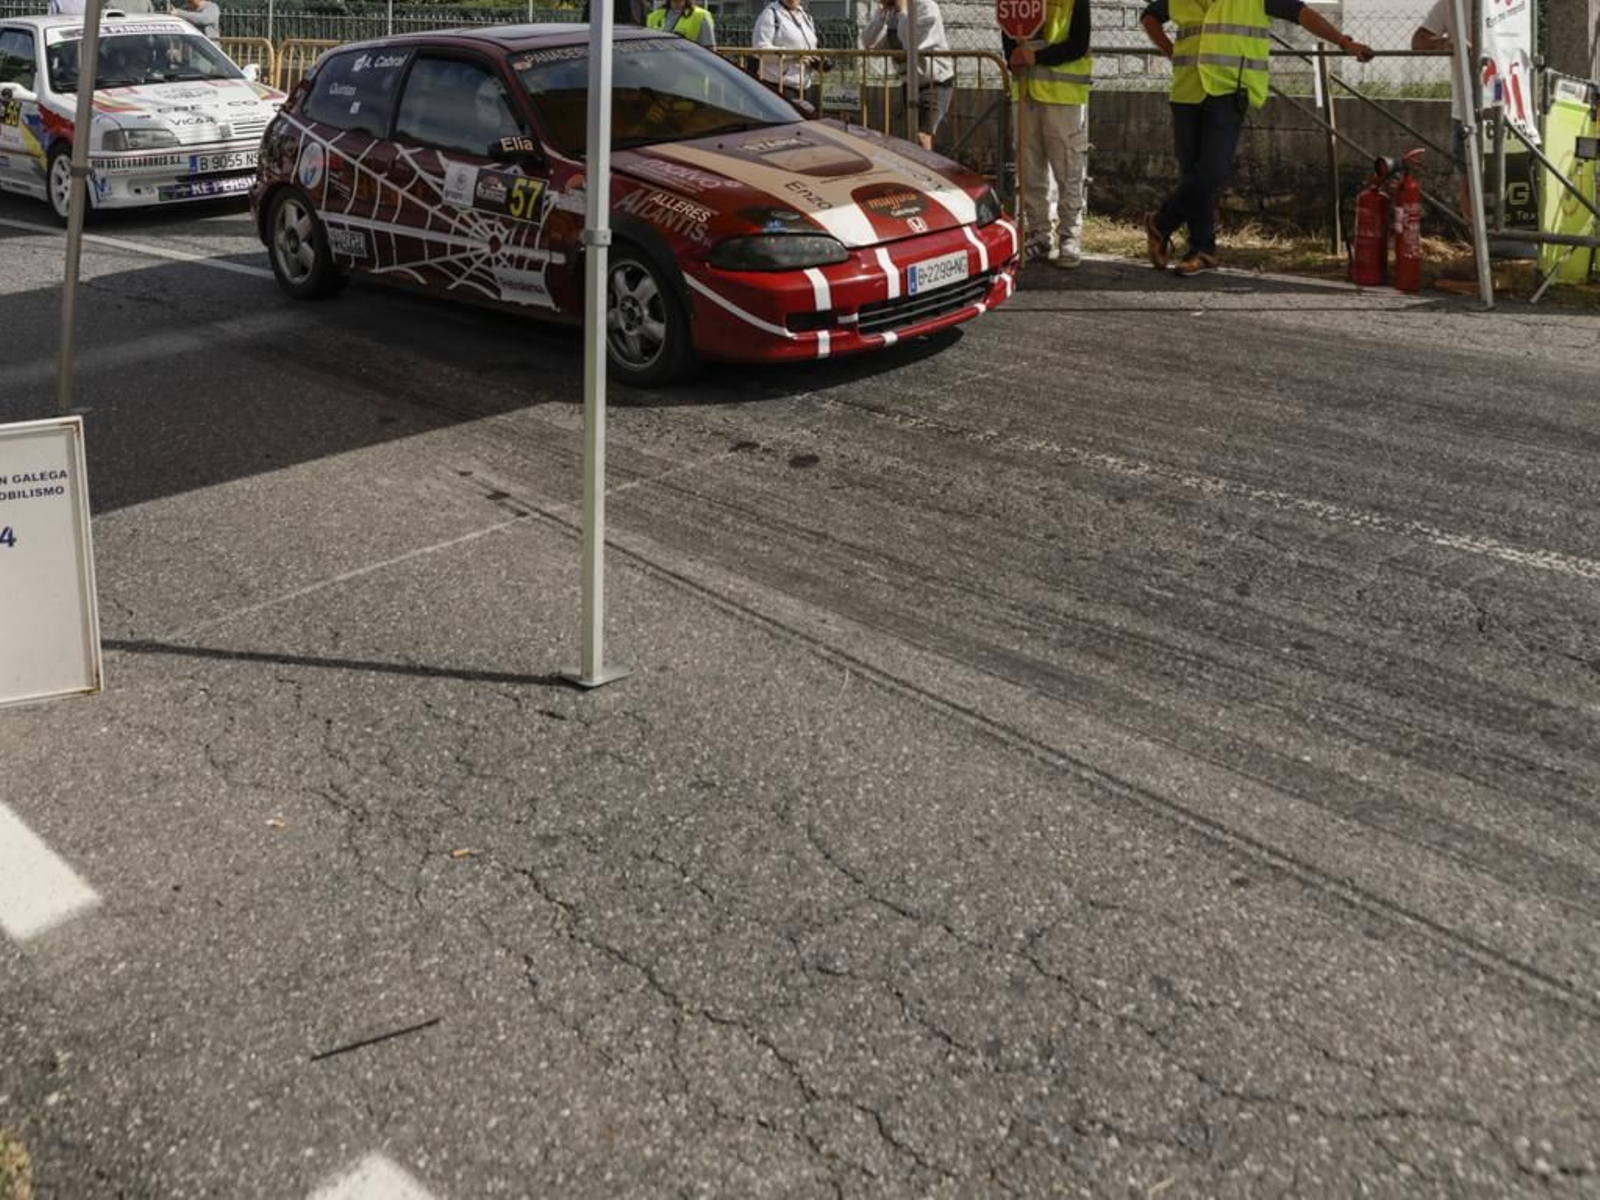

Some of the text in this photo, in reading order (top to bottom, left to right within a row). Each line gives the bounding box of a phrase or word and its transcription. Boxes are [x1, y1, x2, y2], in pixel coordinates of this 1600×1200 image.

[999, 0, 1041, 19] STOP
[501, 137, 534, 151] Elia
[200, 157, 209, 170] B
[212, 154, 243, 168] 9055
[510, 177, 544, 219] 57
[784, 180, 833, 211] Enzo
[12, 469, 68, 484] GALEGA
